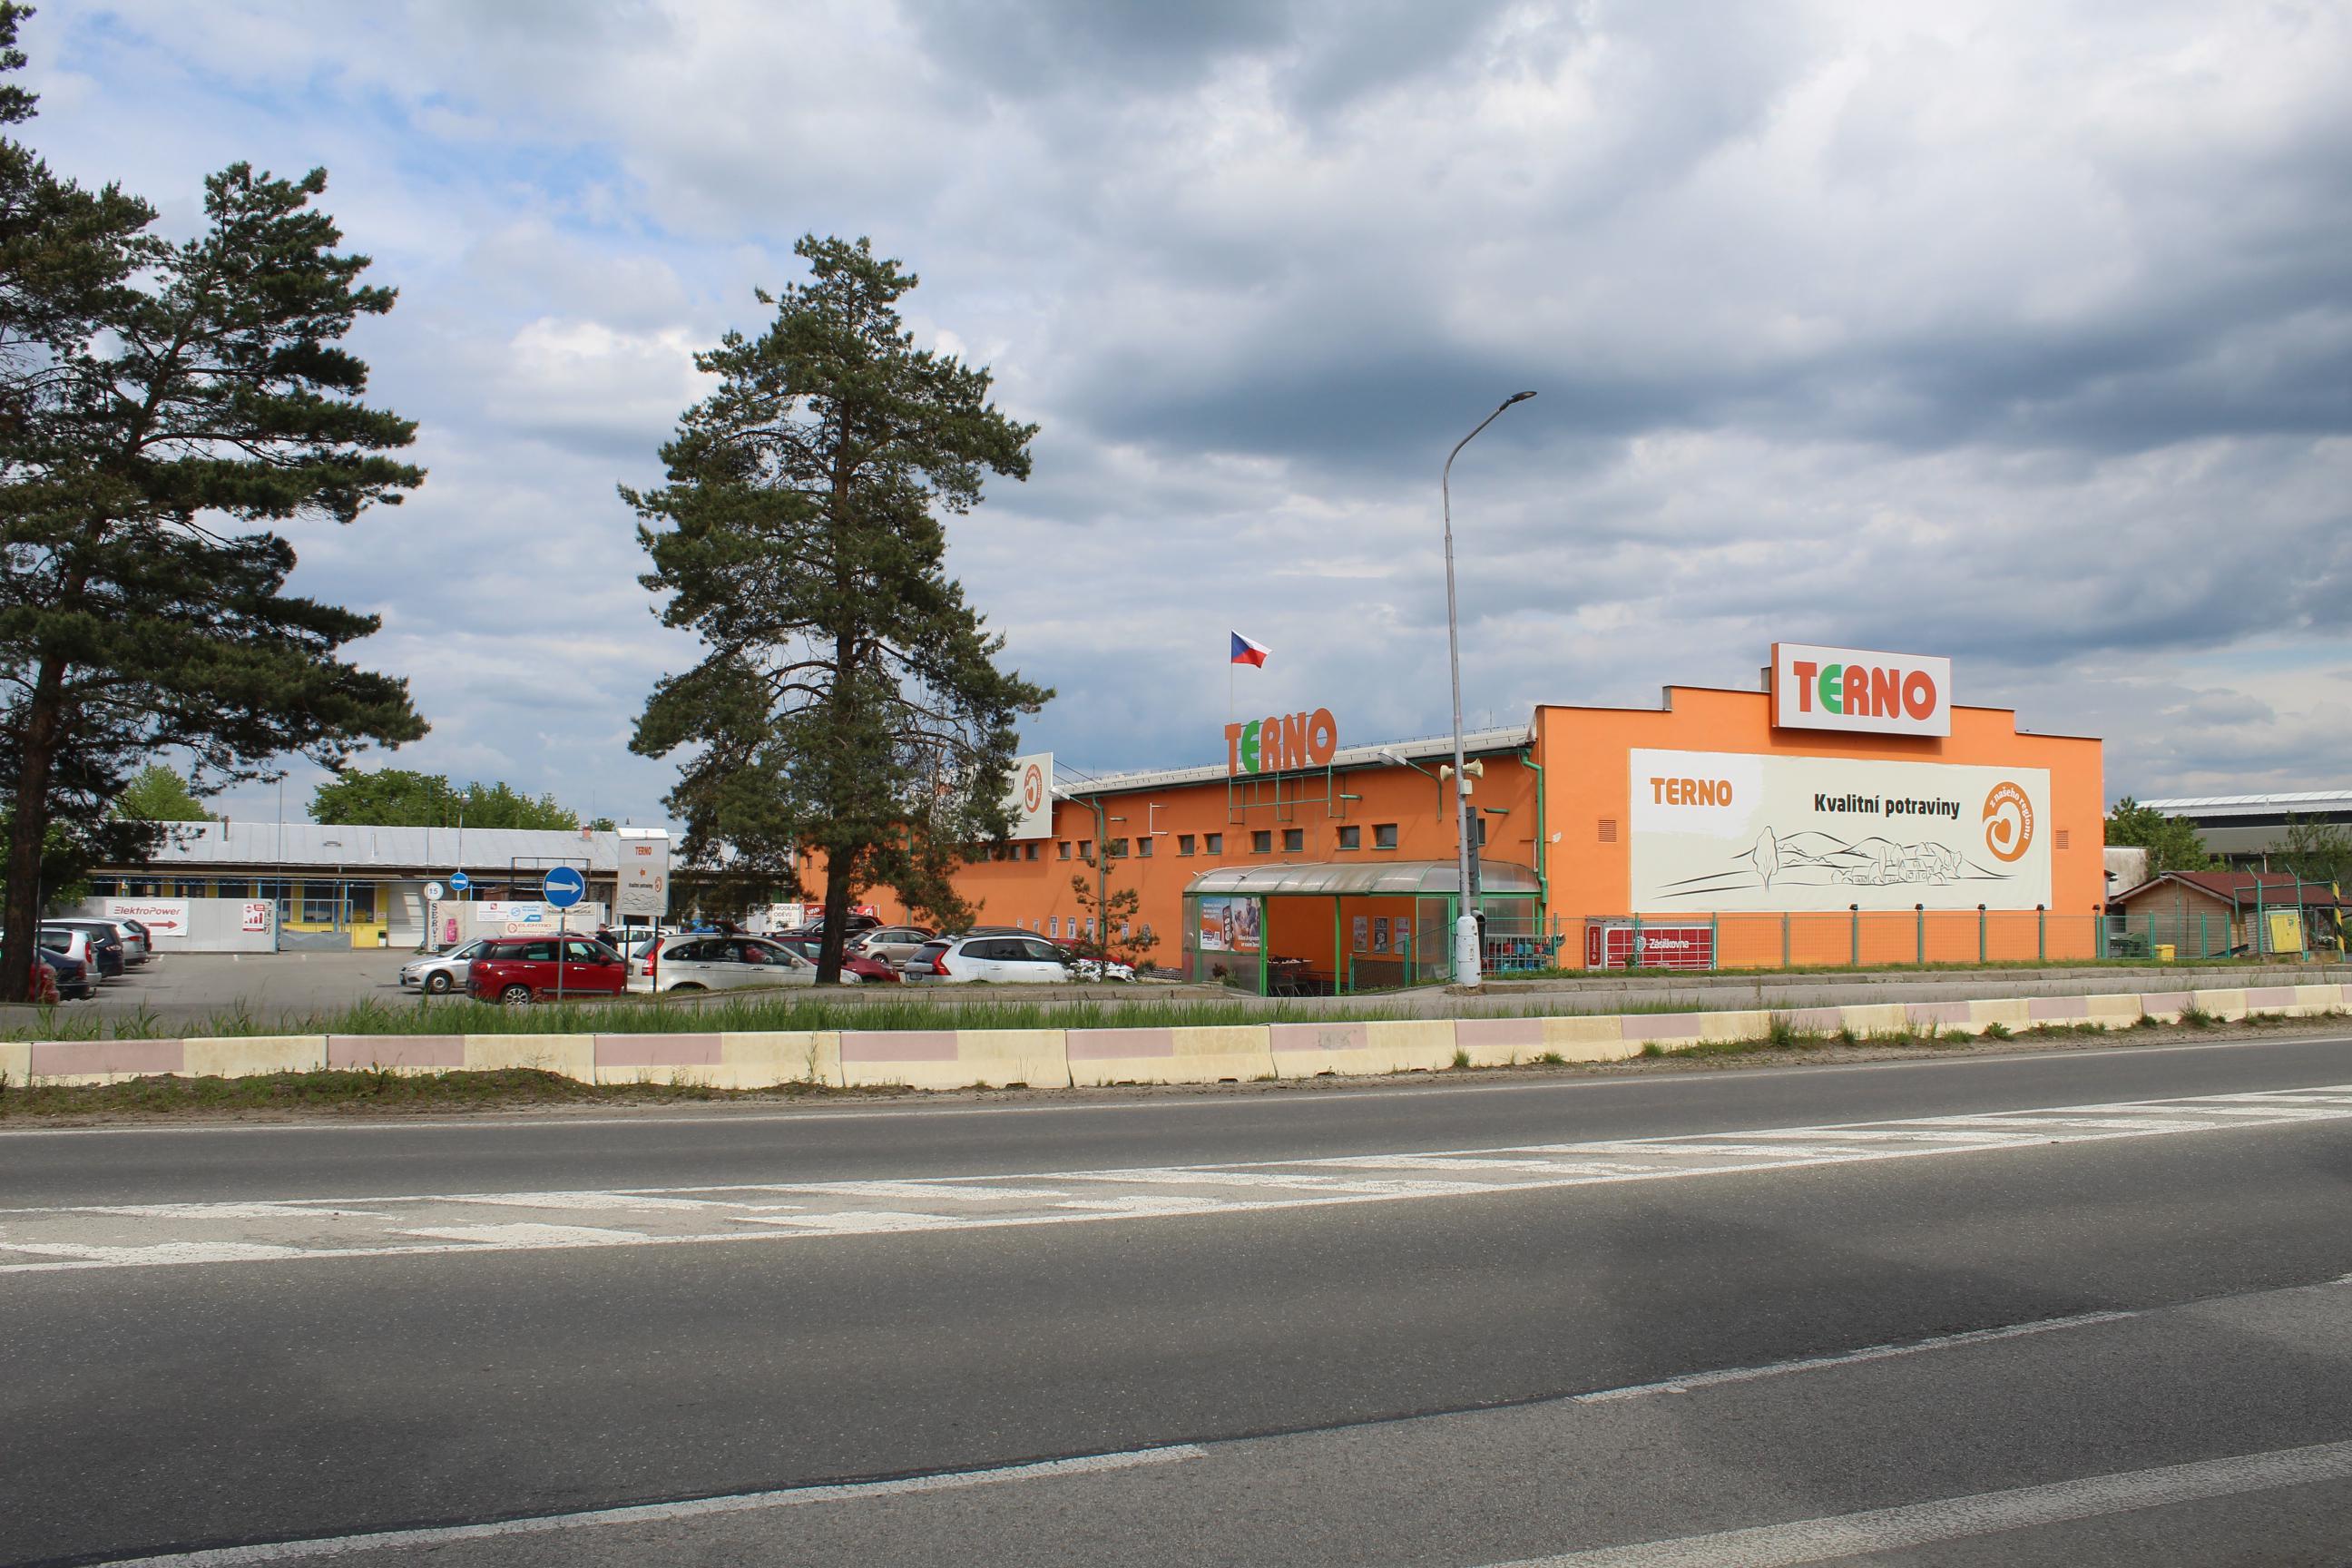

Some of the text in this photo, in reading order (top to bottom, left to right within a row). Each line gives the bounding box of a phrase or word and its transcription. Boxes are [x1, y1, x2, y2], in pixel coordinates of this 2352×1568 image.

[1793, 661, 1937, 720] TERNO
[1224, 708, 1338, 778] TERNO
[1650, 777, 1733, 807] TERNO
[1814, 793, 1960, 820] Kvalitní potraviny
[1994, 786, 2020, 802] našeho
[2018, 798, 2032, 840] regionu
[635, 847, 652, 856] TERNO
[114, 906, 181, 916] ElektroPower
[1649, 938, 1690, 949] Zásilkovna
